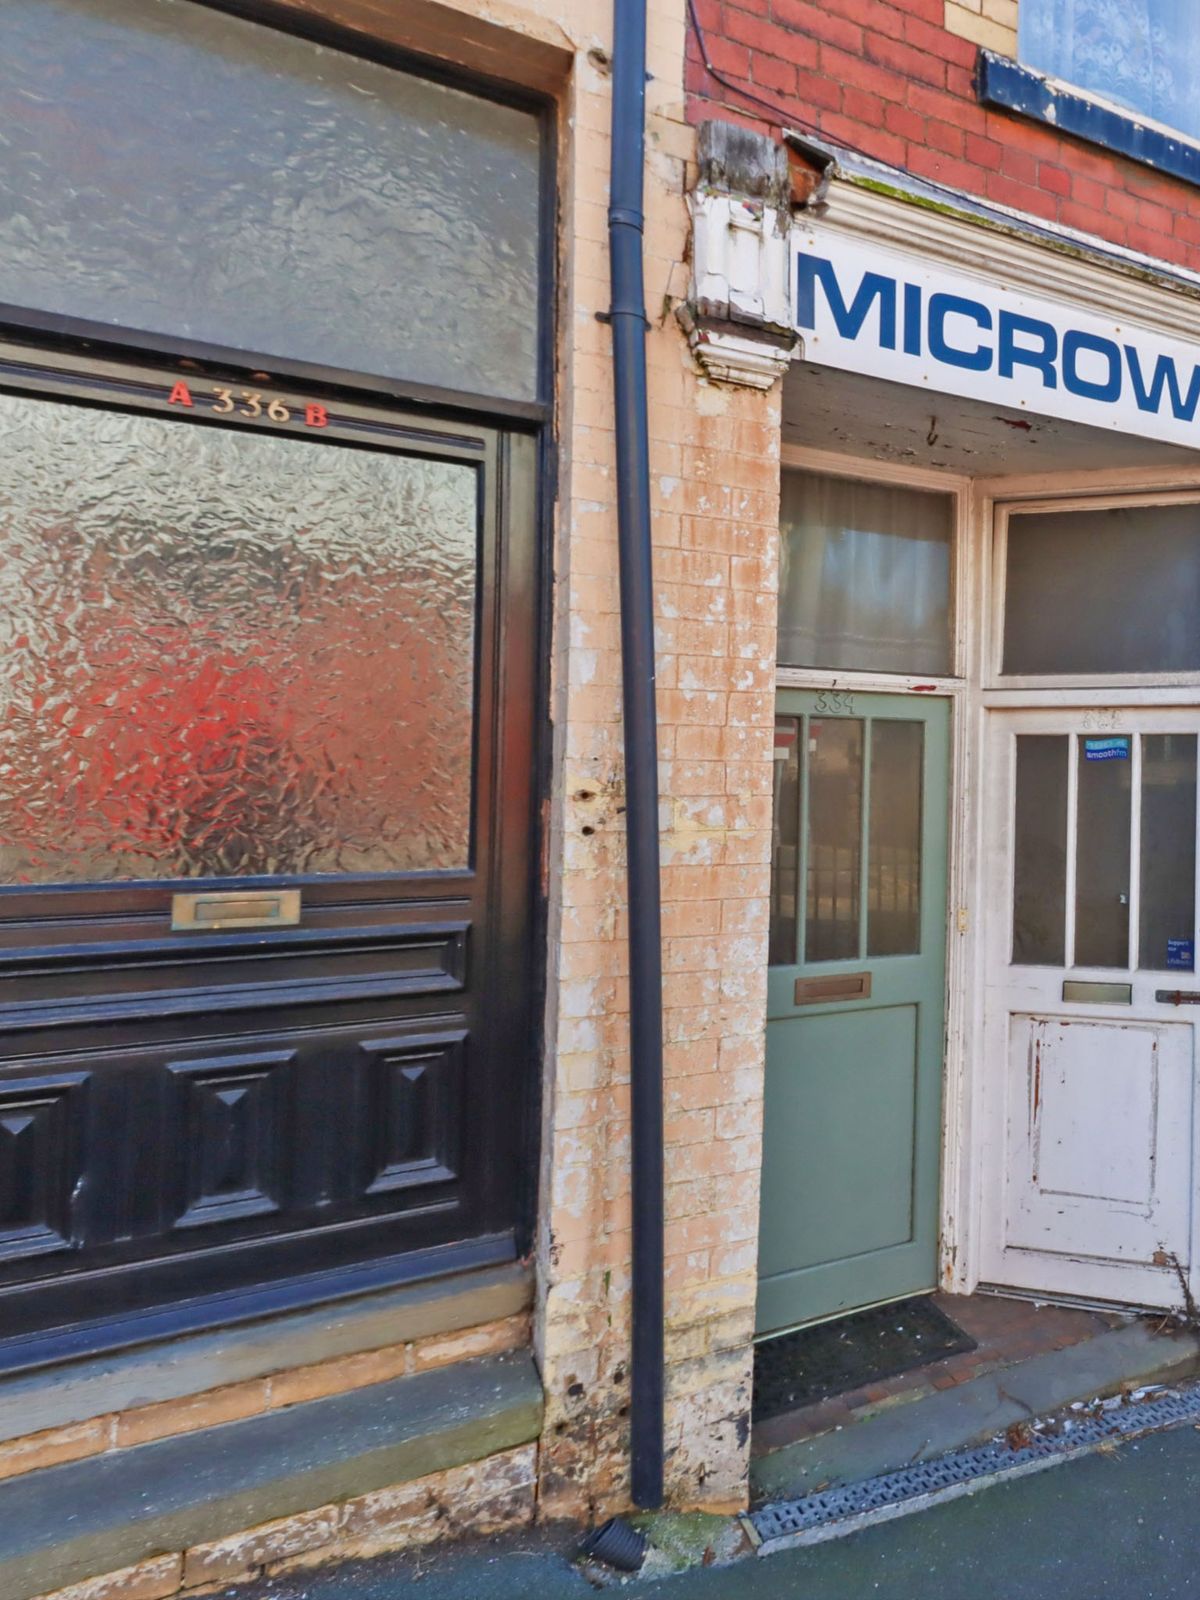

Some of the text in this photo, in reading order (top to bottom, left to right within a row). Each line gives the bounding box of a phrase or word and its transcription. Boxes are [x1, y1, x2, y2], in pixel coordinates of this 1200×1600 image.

[168, 380, 328, 428] A 336 B
